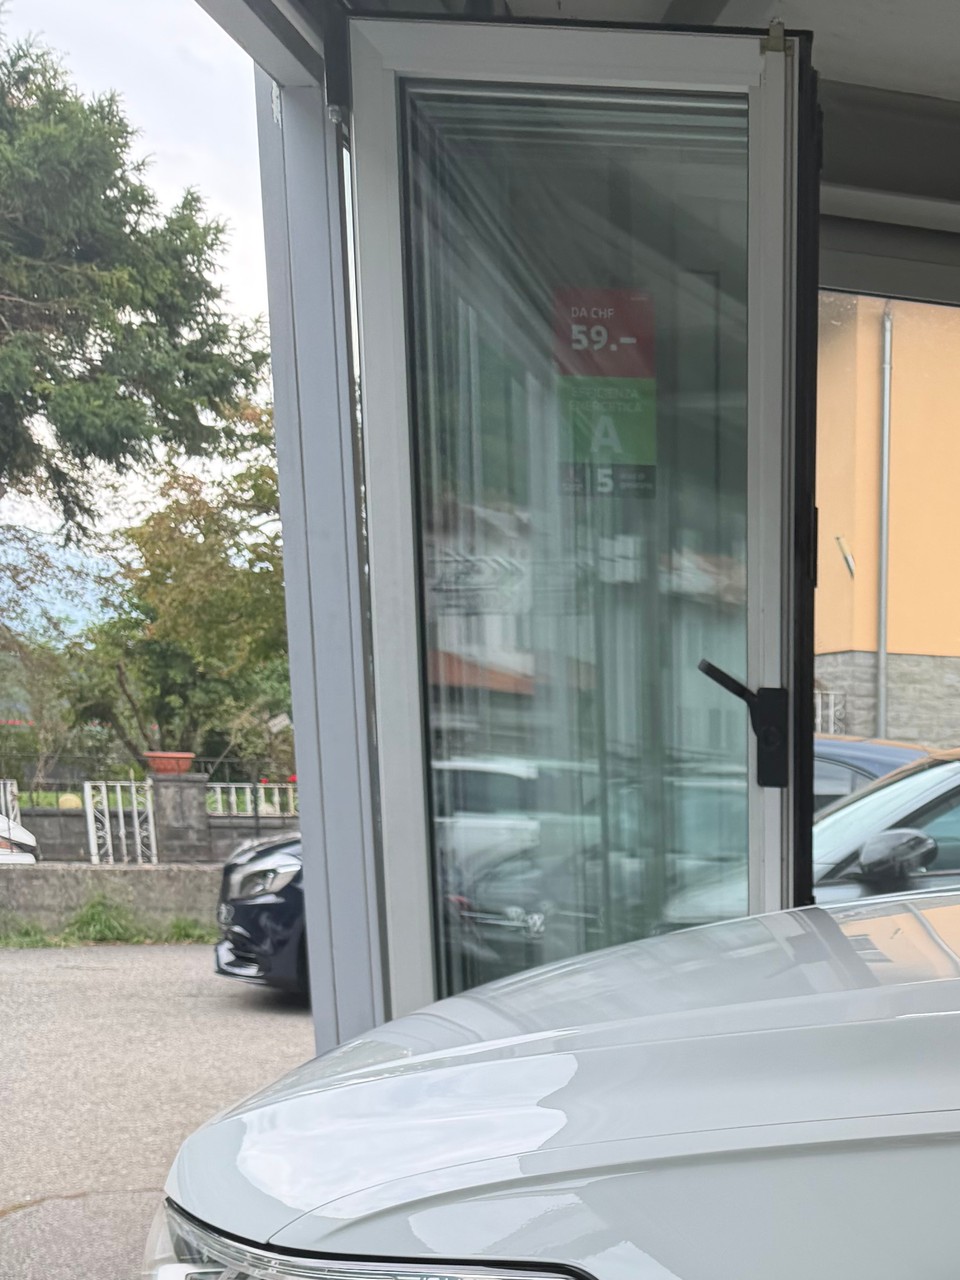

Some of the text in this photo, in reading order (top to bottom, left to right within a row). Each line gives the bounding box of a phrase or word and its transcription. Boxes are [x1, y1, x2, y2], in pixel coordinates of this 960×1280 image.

[571, 307, 615, 320] DA CHF
[571, 324, 637, 351] 59.-
[591, 416, 622, 452] A
[597, 467, 614, 493] 5
